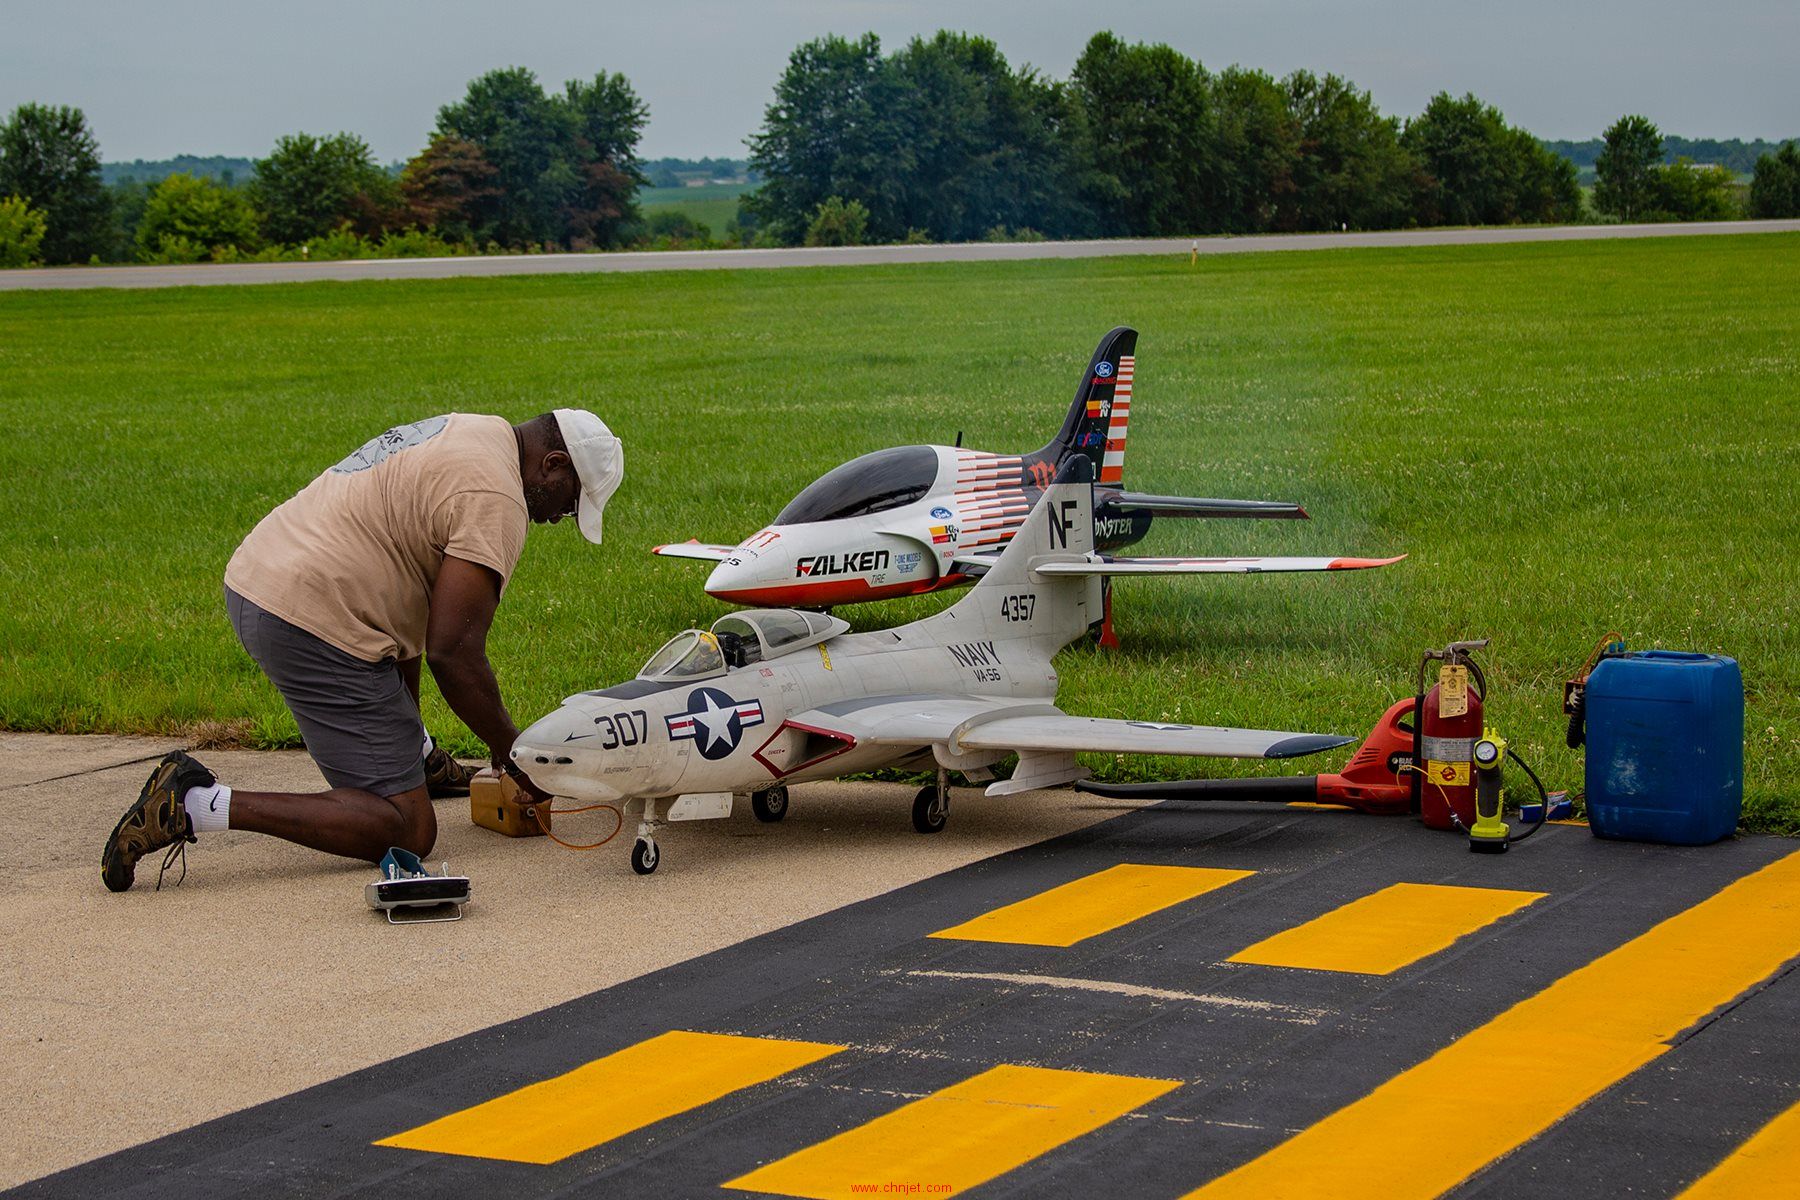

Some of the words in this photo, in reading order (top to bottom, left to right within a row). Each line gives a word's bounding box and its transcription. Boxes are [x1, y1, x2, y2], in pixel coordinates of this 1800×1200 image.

[1047, 500, 1077, 550] NF
[795, 550, 889, 578] FALKEN
[870, 573, 887, 585] TIRE
[1001, 594, 1036, 622] 4357
[947, 641, 1001, 667] NAVY
[973, 668, 1001, 682] VA-56
[594, 709, 647, 750] 307
